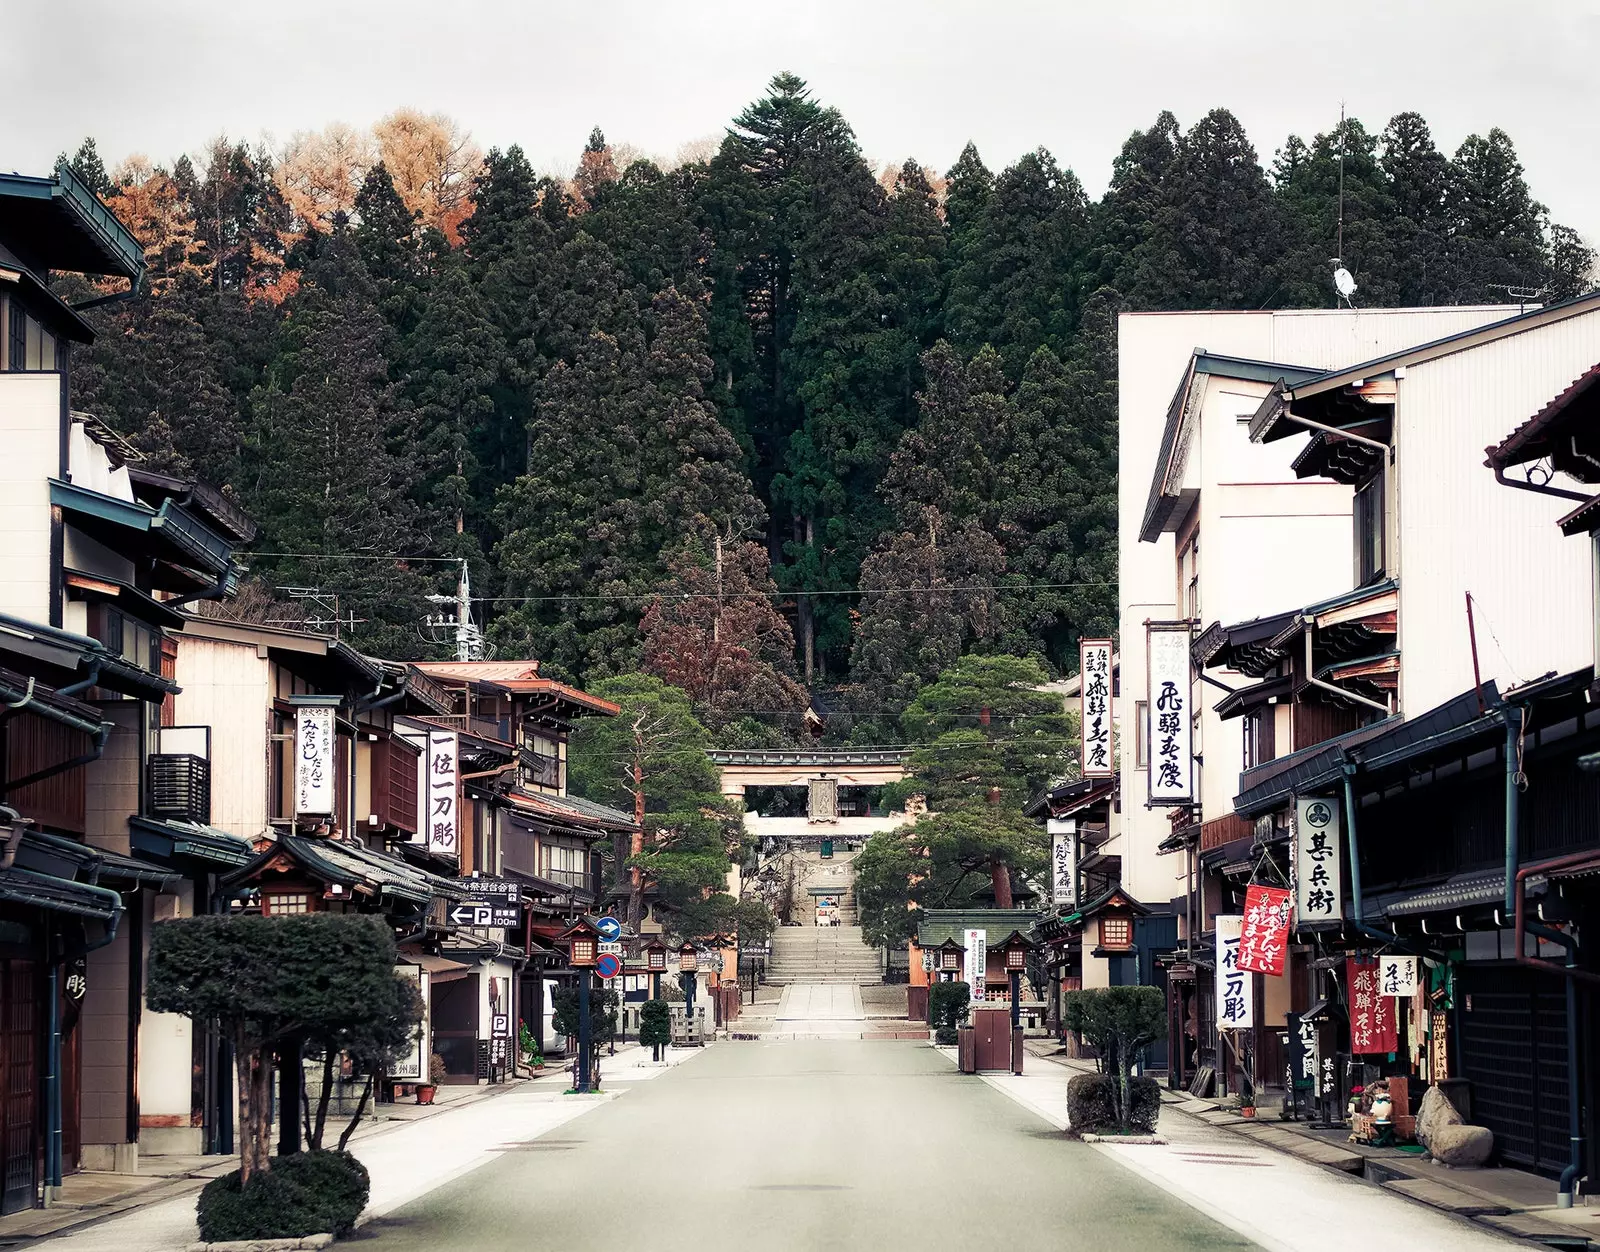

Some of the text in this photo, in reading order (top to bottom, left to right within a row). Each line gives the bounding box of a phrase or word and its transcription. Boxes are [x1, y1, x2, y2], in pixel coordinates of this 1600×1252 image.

[431, 736, 455, 848] 一位一刀彫
[1305, 830, 1336, 915] 甚兵衛
[494, 917, 517, 926] 100m
[1384, 963, 1404, 993] そば
